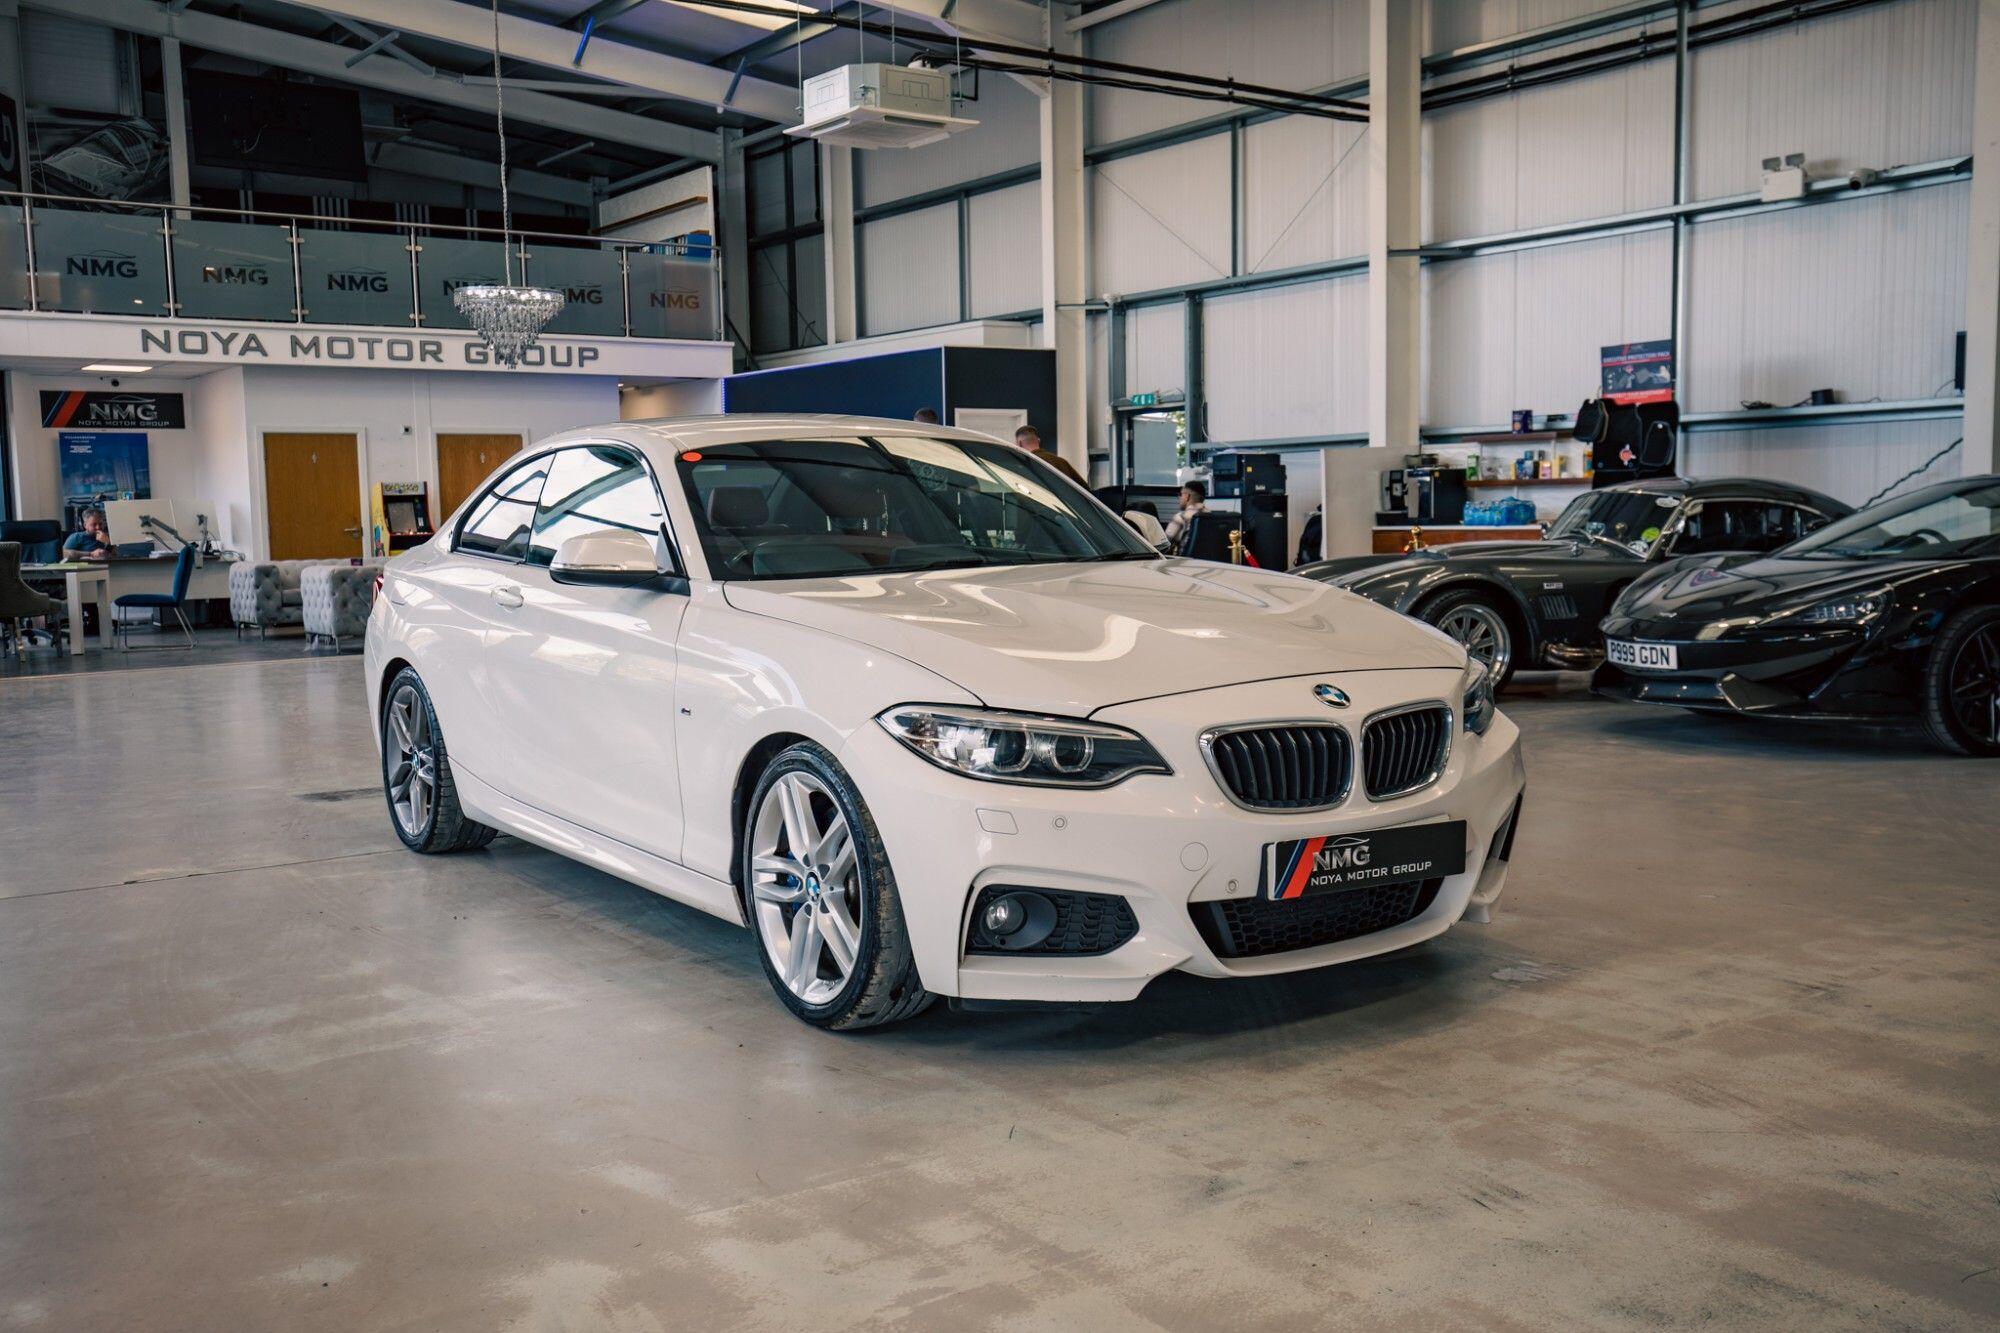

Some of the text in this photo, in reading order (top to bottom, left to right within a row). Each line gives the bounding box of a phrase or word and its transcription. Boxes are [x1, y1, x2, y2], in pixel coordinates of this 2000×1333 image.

[66, 257, 138, 278] NMG
[203, 266, 268, 285] NMG
[327, 273, 388, 292] NMG
[564, 287, 603, 304] MG
[650, 292, 700, 309] NMG
[141, 328, 268, 357] NOYA
[290, 335, 444, 363] MOTOR
[89, 402, 158, 421] NMG
[1610, 642, 1670, 666] P999 GDN
[1312, 845, 1370, 872] NMG
[1310, 861, 1432, 886] NOYA MOTOR GROUP
